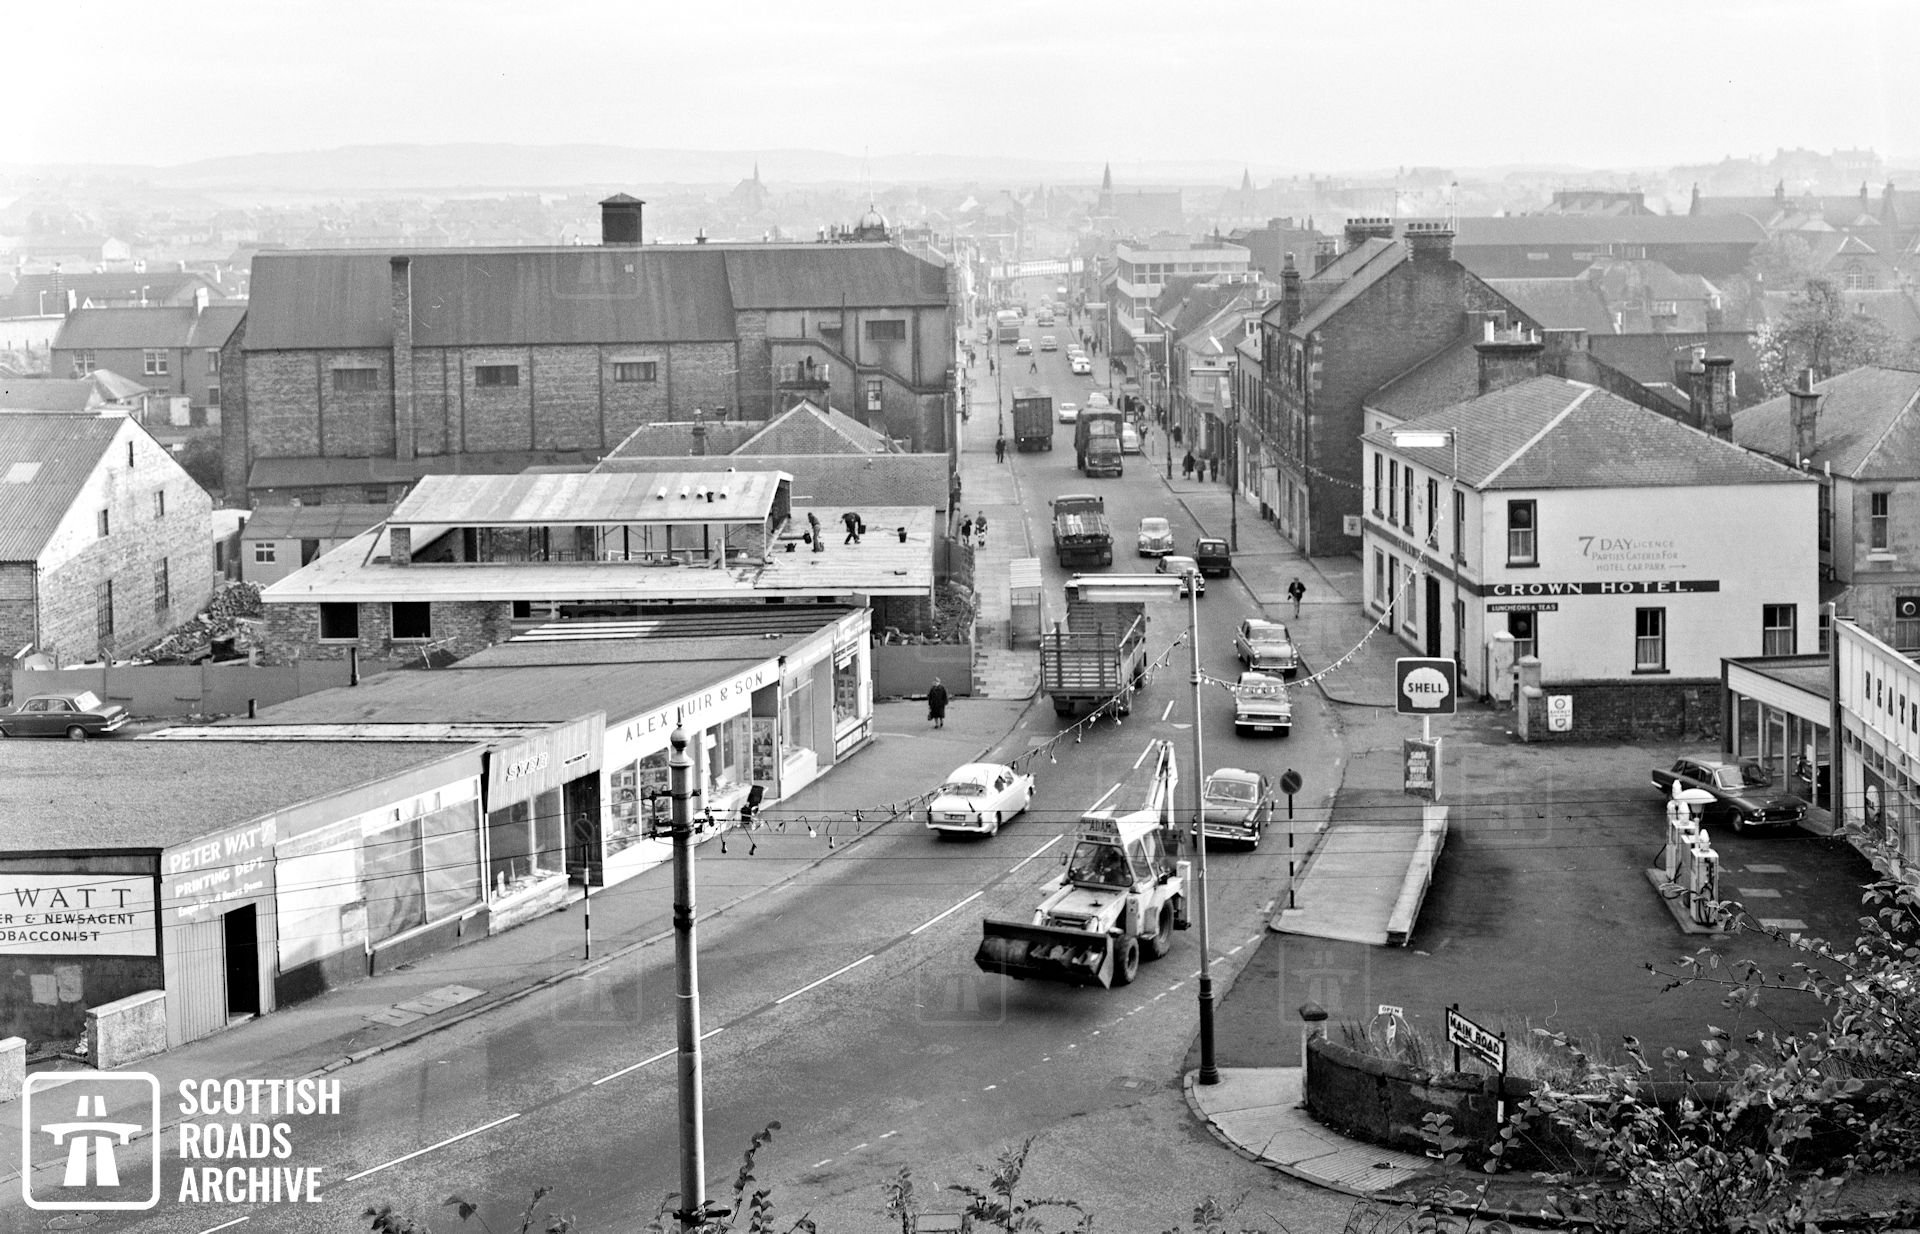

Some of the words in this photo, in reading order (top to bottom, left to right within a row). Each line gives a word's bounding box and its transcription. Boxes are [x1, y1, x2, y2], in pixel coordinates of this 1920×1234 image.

[1578, 535, 1596, 557] 7
[1600, 538, 1634, 551] DAY
[1493, 583, 1583, 596] CROWN
[1600, 581, 1695, 594] HOTEL.
[1491, 604, 1531, 612] LUNCHEONS
[1538, 603, 1557, 611] TEAS
[1408, 682, 1445, 693] SHELL
[625, 711, 668, 743] ALEX
[677, 693, 713, 719] MUIR
[720, 687, 729, 702] &
[735, 671, 764, 695] SON
[169, 841, 221, 873] PETER
[224, 827, 263, 856] WAT
[175, 868, 231, 898] PRINTING
[14, 888, 132, 908] WATT
[25, 913, 36, 924] &
[45, 913, 135, 925] NEWSAGENT
[1450, 1015, 1472, 1037] MAIN
[1475, 1031, 1500, 1055] ROAD
